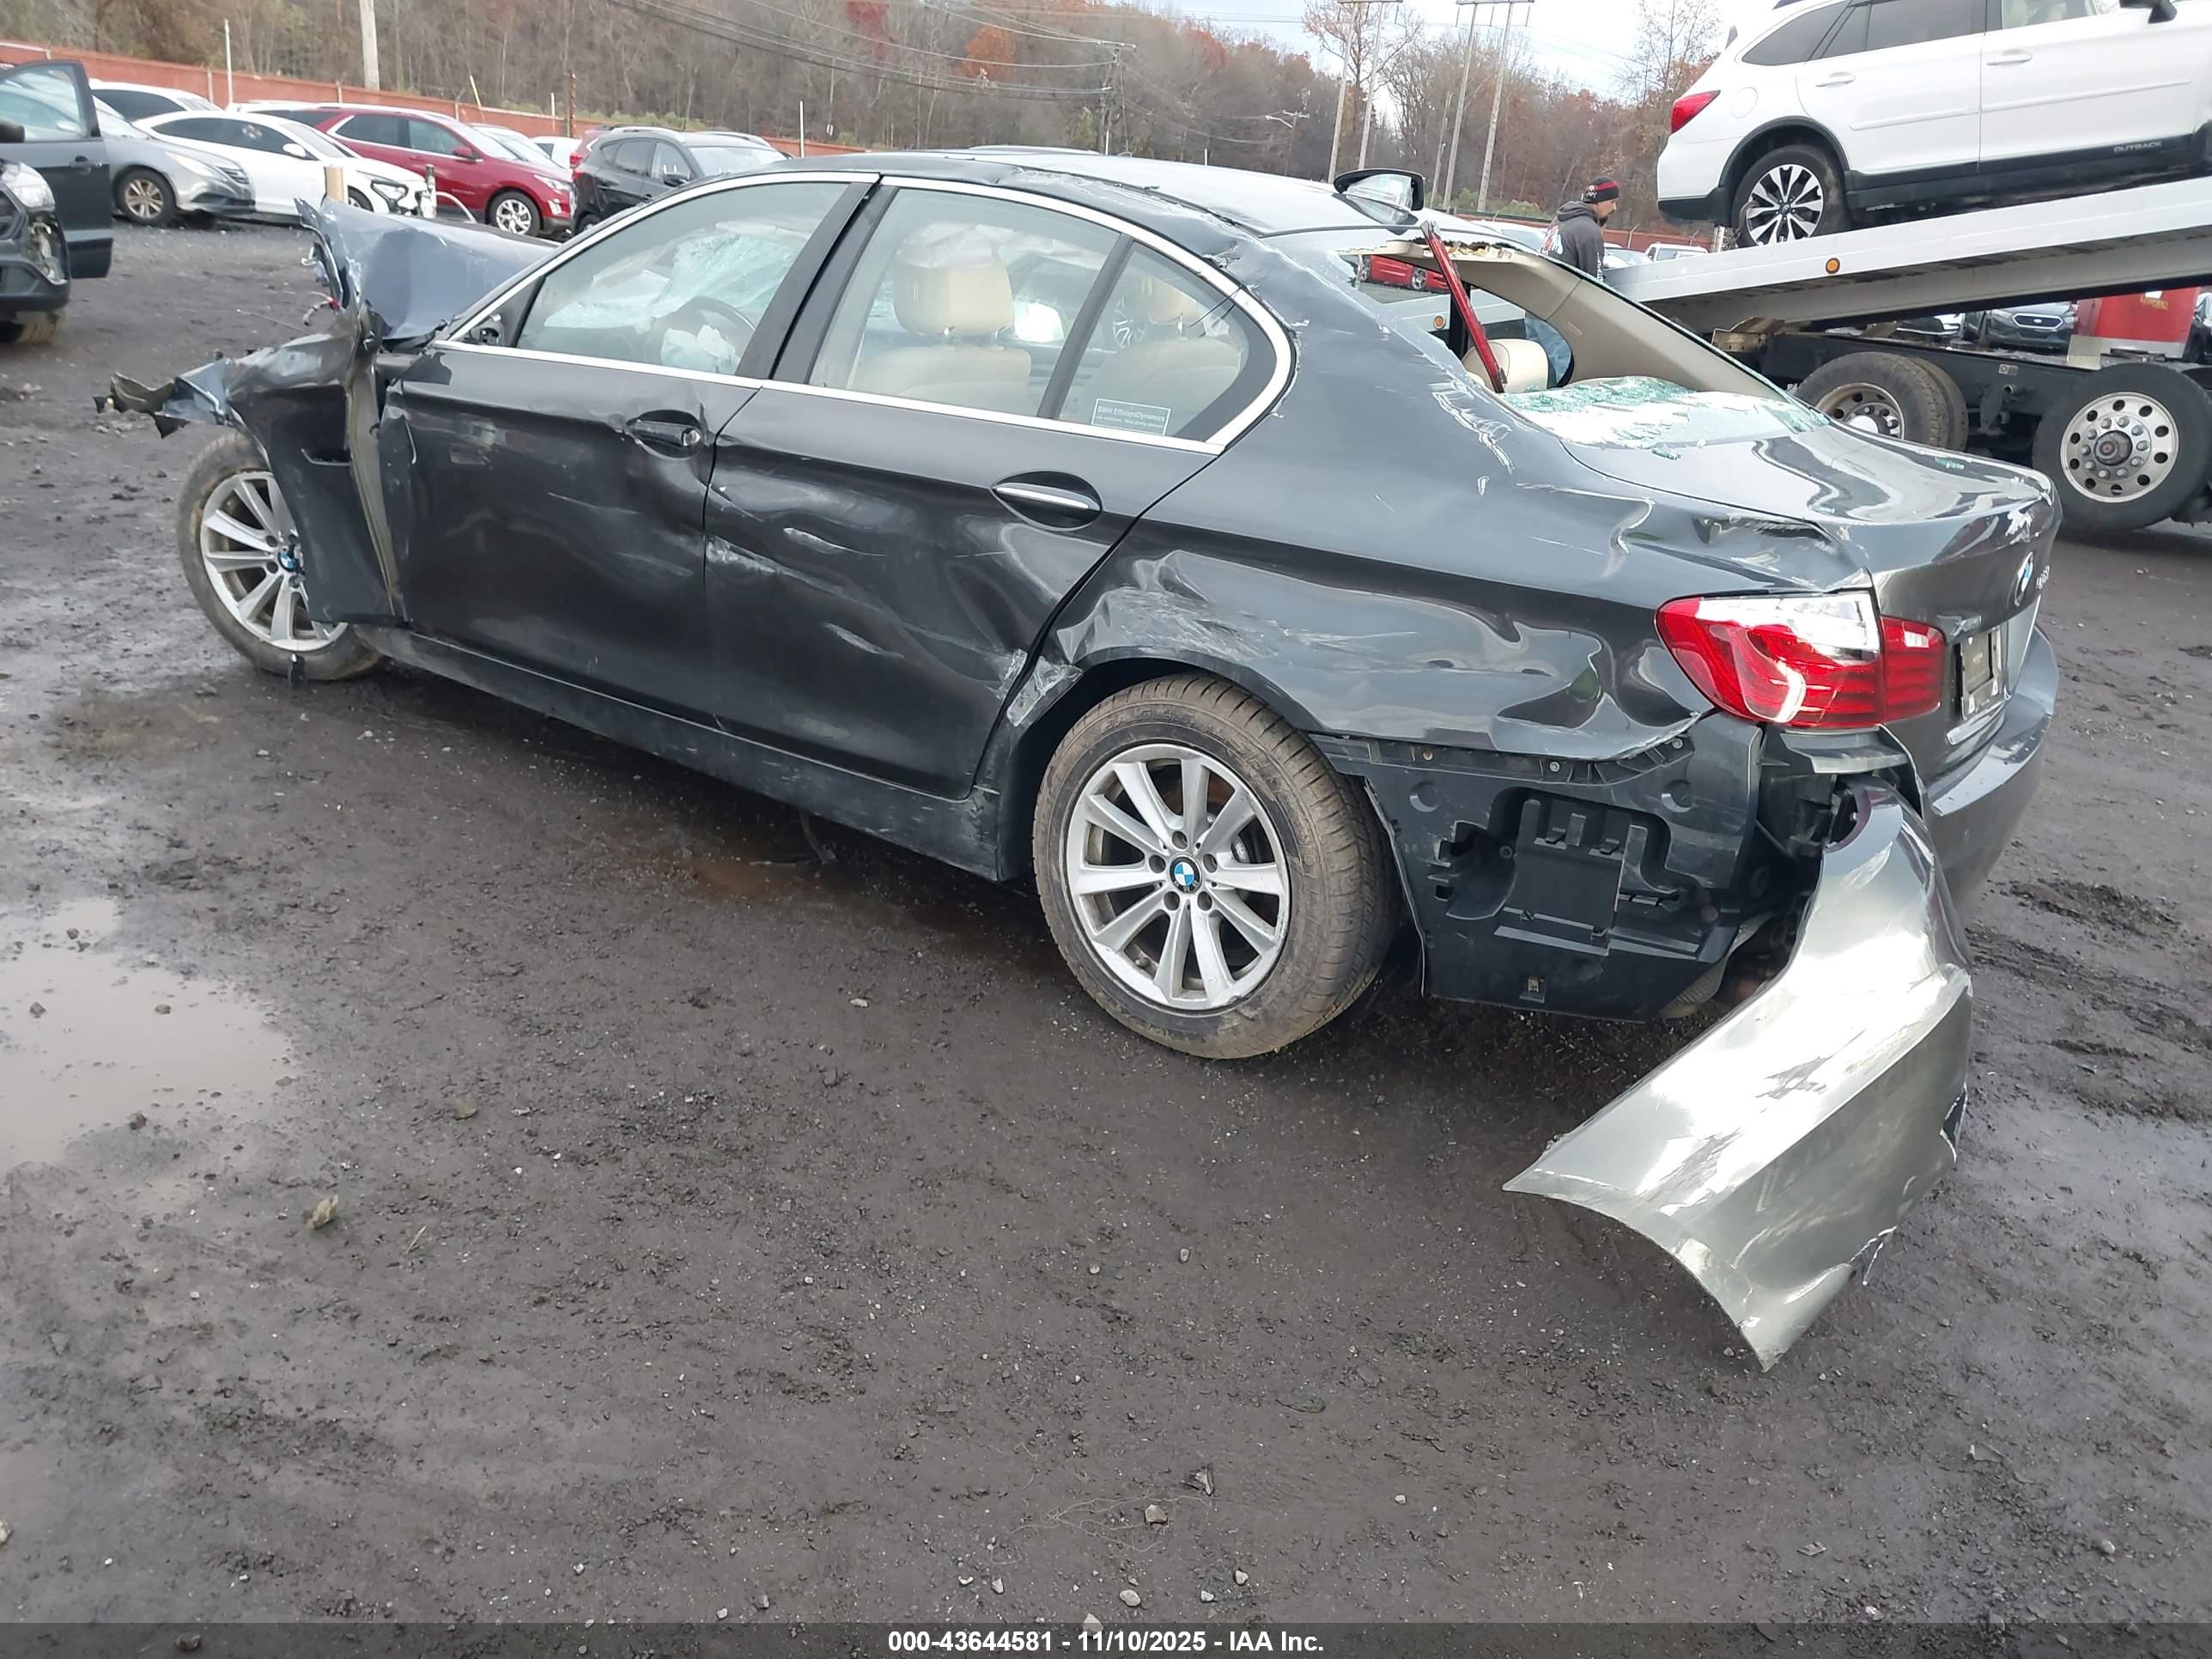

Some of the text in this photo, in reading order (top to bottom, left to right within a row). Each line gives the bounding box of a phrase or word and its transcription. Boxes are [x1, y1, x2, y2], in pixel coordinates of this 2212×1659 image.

[2113, 140, 2163, 153] OUTBACK
[1097, 404, 1165, 422] BMW EfficientDynamics
